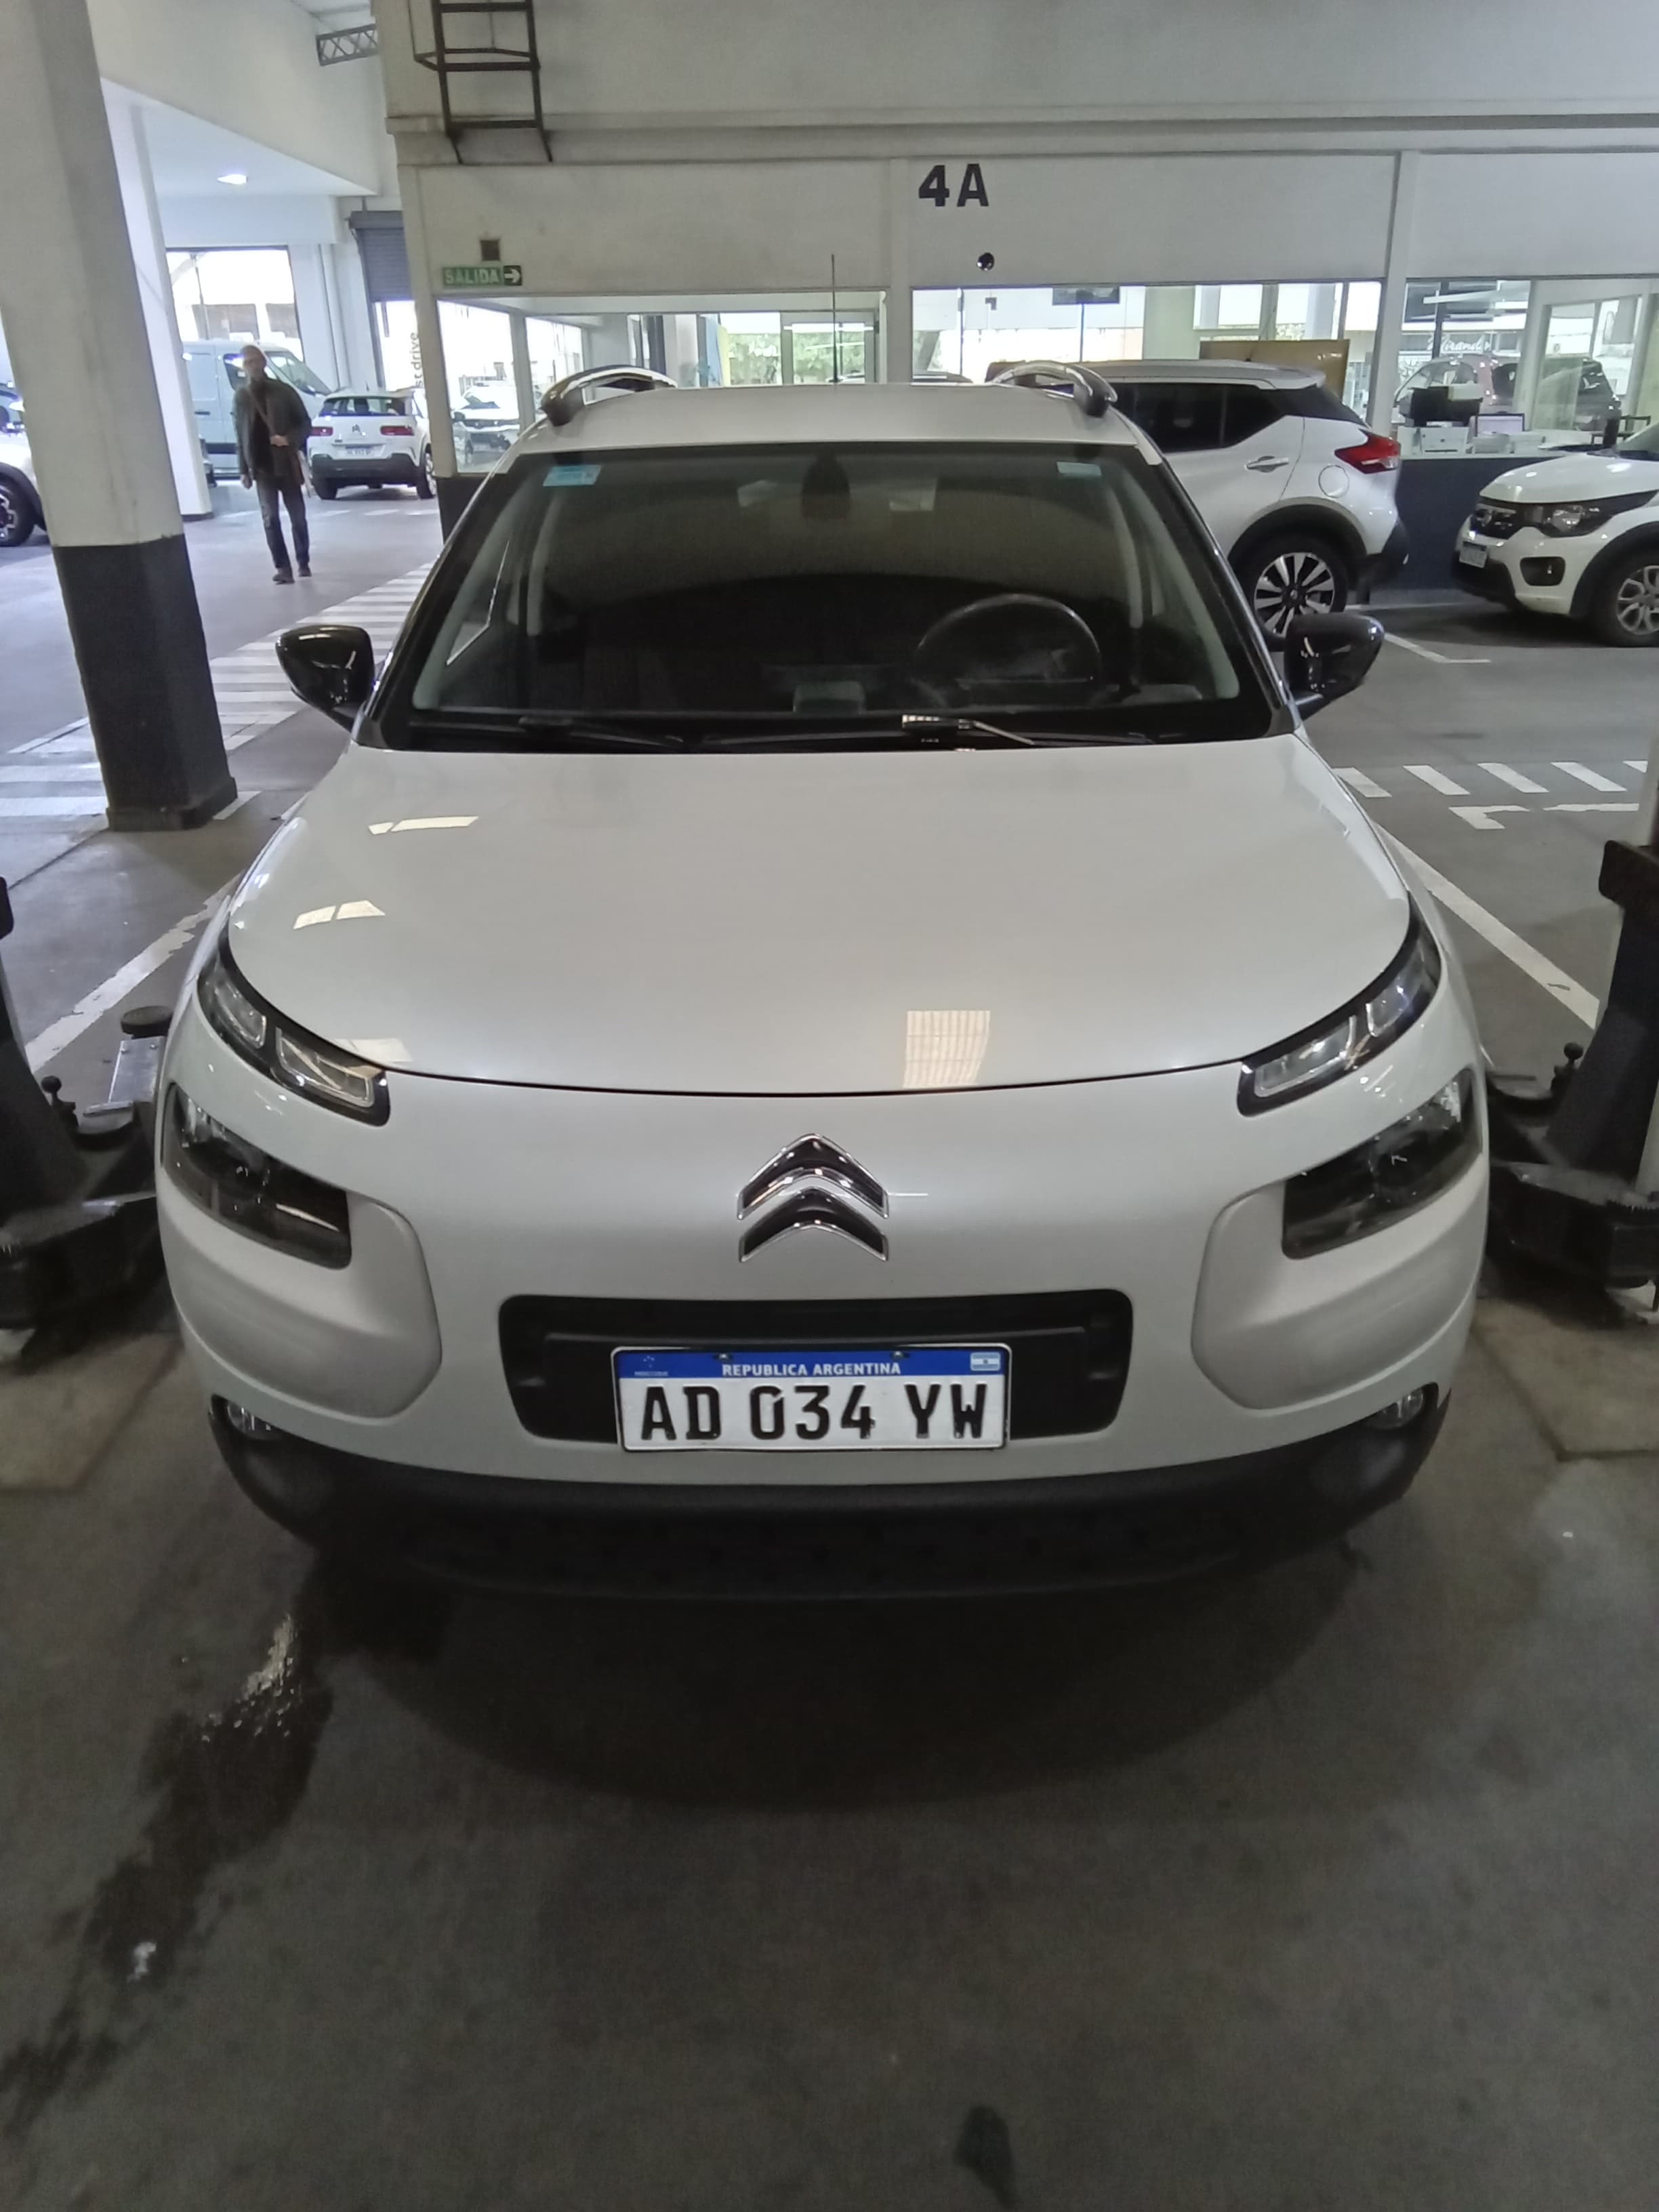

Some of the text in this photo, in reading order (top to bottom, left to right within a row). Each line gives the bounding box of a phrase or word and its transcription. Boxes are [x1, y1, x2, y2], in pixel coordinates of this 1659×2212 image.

[918, 163, 989, 207] 4A
[444, 268, 499, 284] SALIDA
[410, 332, 421, 370] drive
[722, 1362, 901, 1376] REPUBLICA ARGENTINA
[641, 1383, 987, 1440] AD 034 YW
